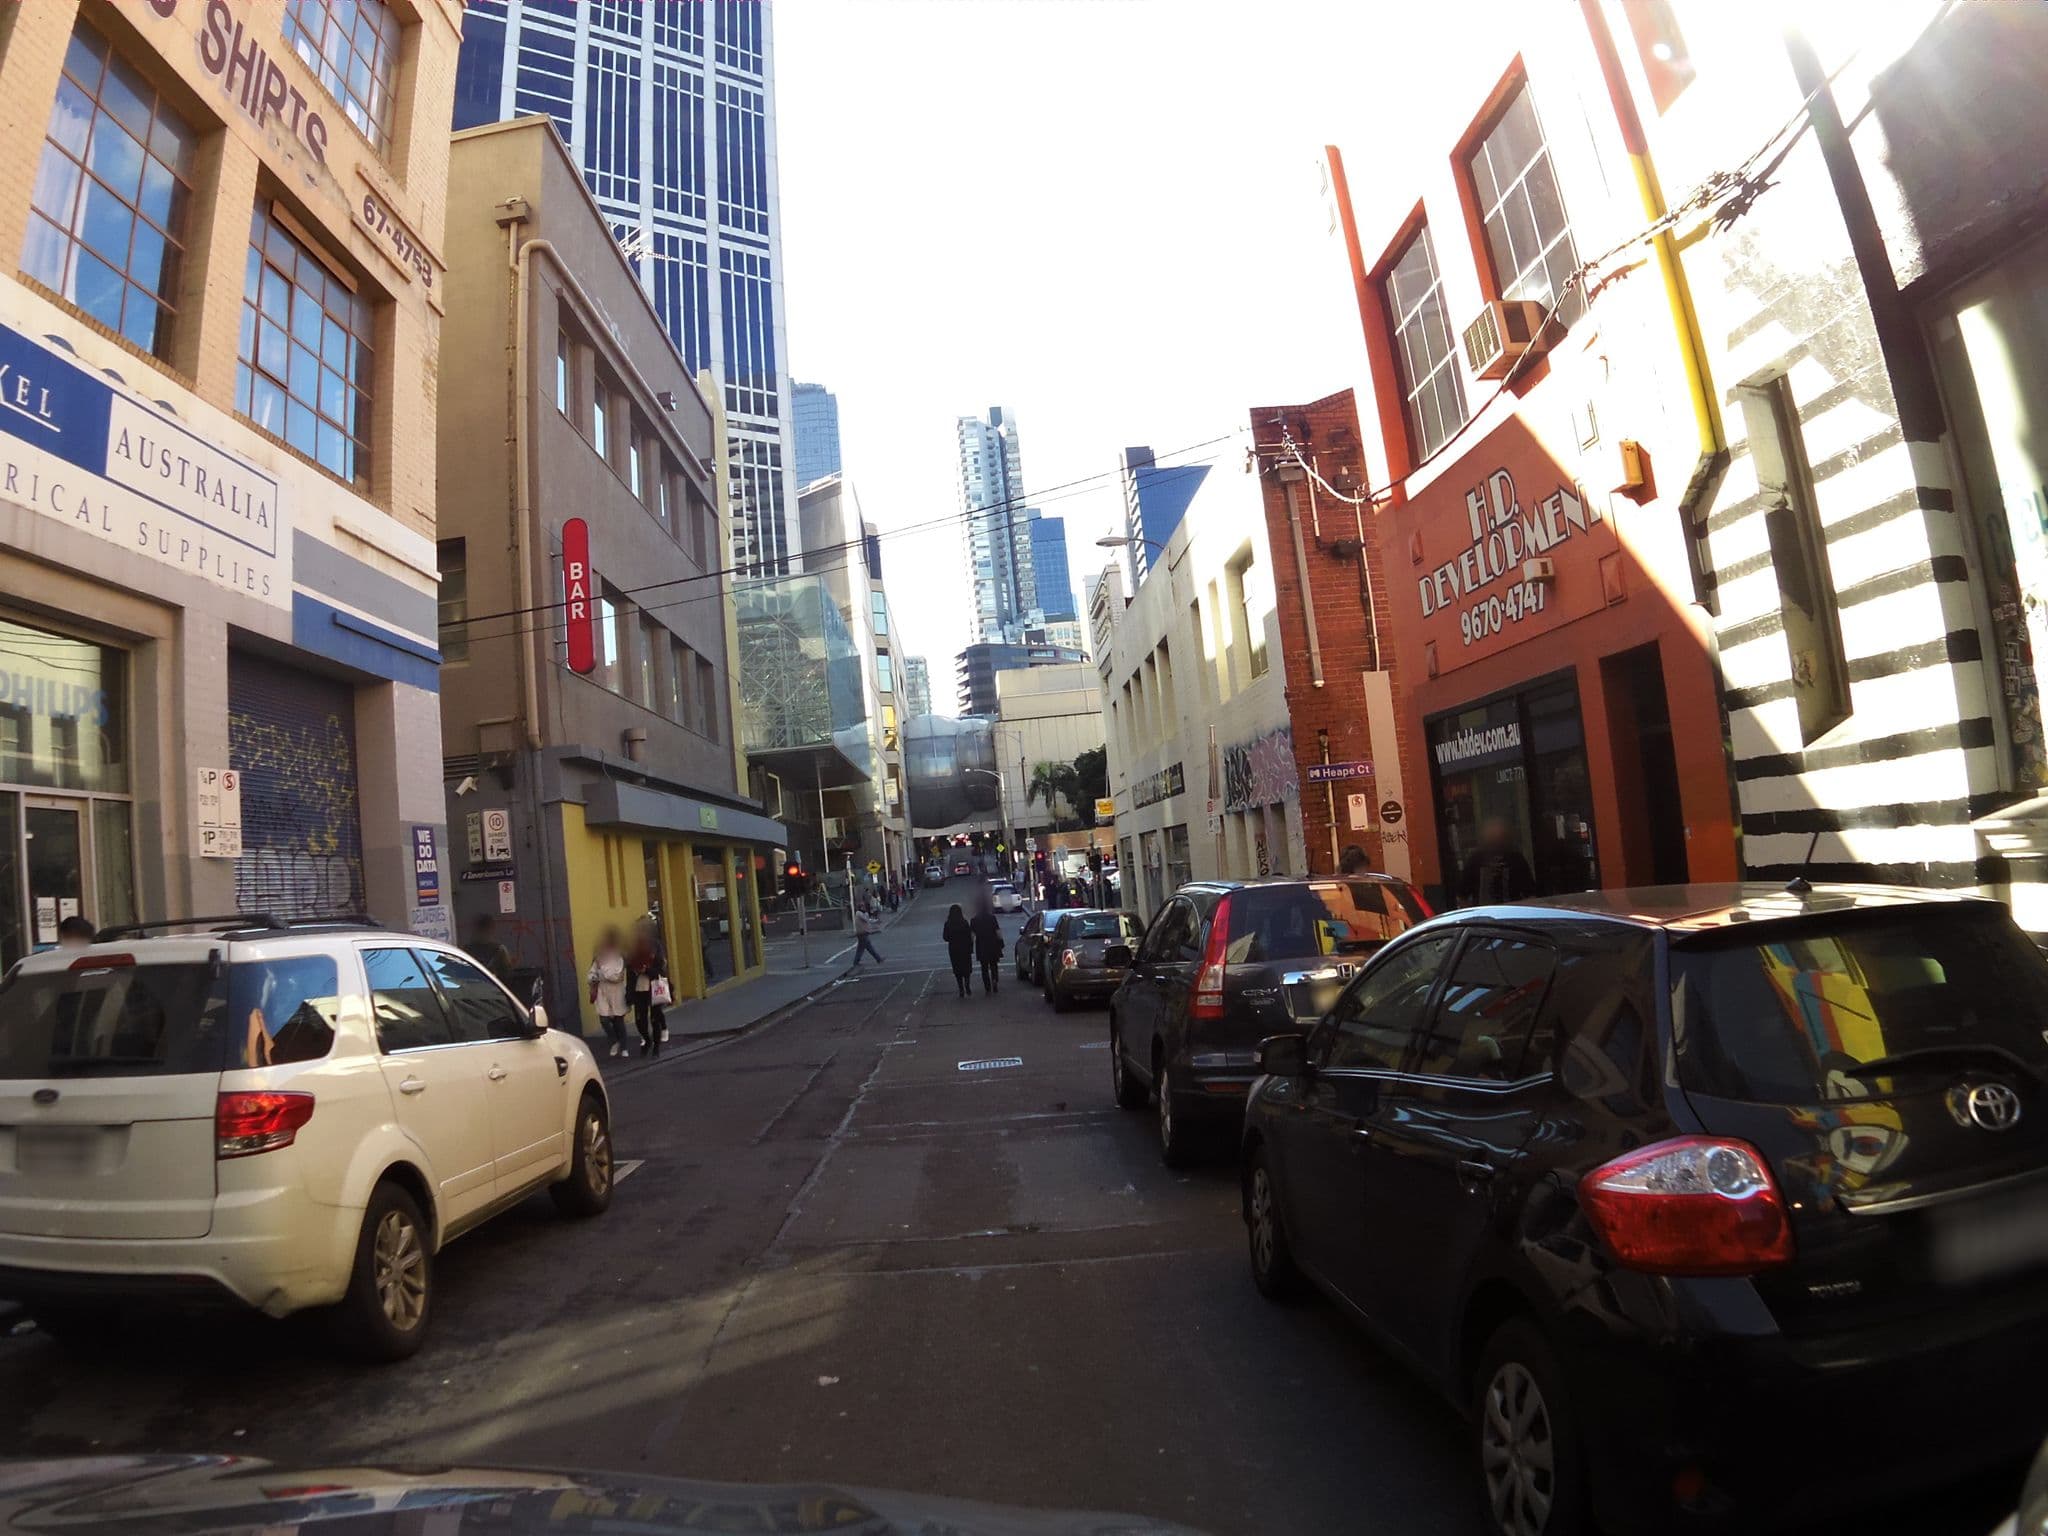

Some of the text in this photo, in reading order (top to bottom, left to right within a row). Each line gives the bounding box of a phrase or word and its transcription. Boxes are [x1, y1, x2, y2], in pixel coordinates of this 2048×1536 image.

[362, 194, 433, 288] 67-4753
[115, 427, 269, 529] AUSTRALIA
[5, 463, 271, 597] RICAL SUPPLIES
[569, 562, 585, 619] BAR
[1435, 722, 1521, 764] www.hddev.com.au
[1322, 765, 1370, 778] Heape Ct
[202, 831, 216, 845] 1P
[417, 829, 431, 843] WE
[418, 845, 433, 858] DO
[416, 860, 437, 873] DATA
